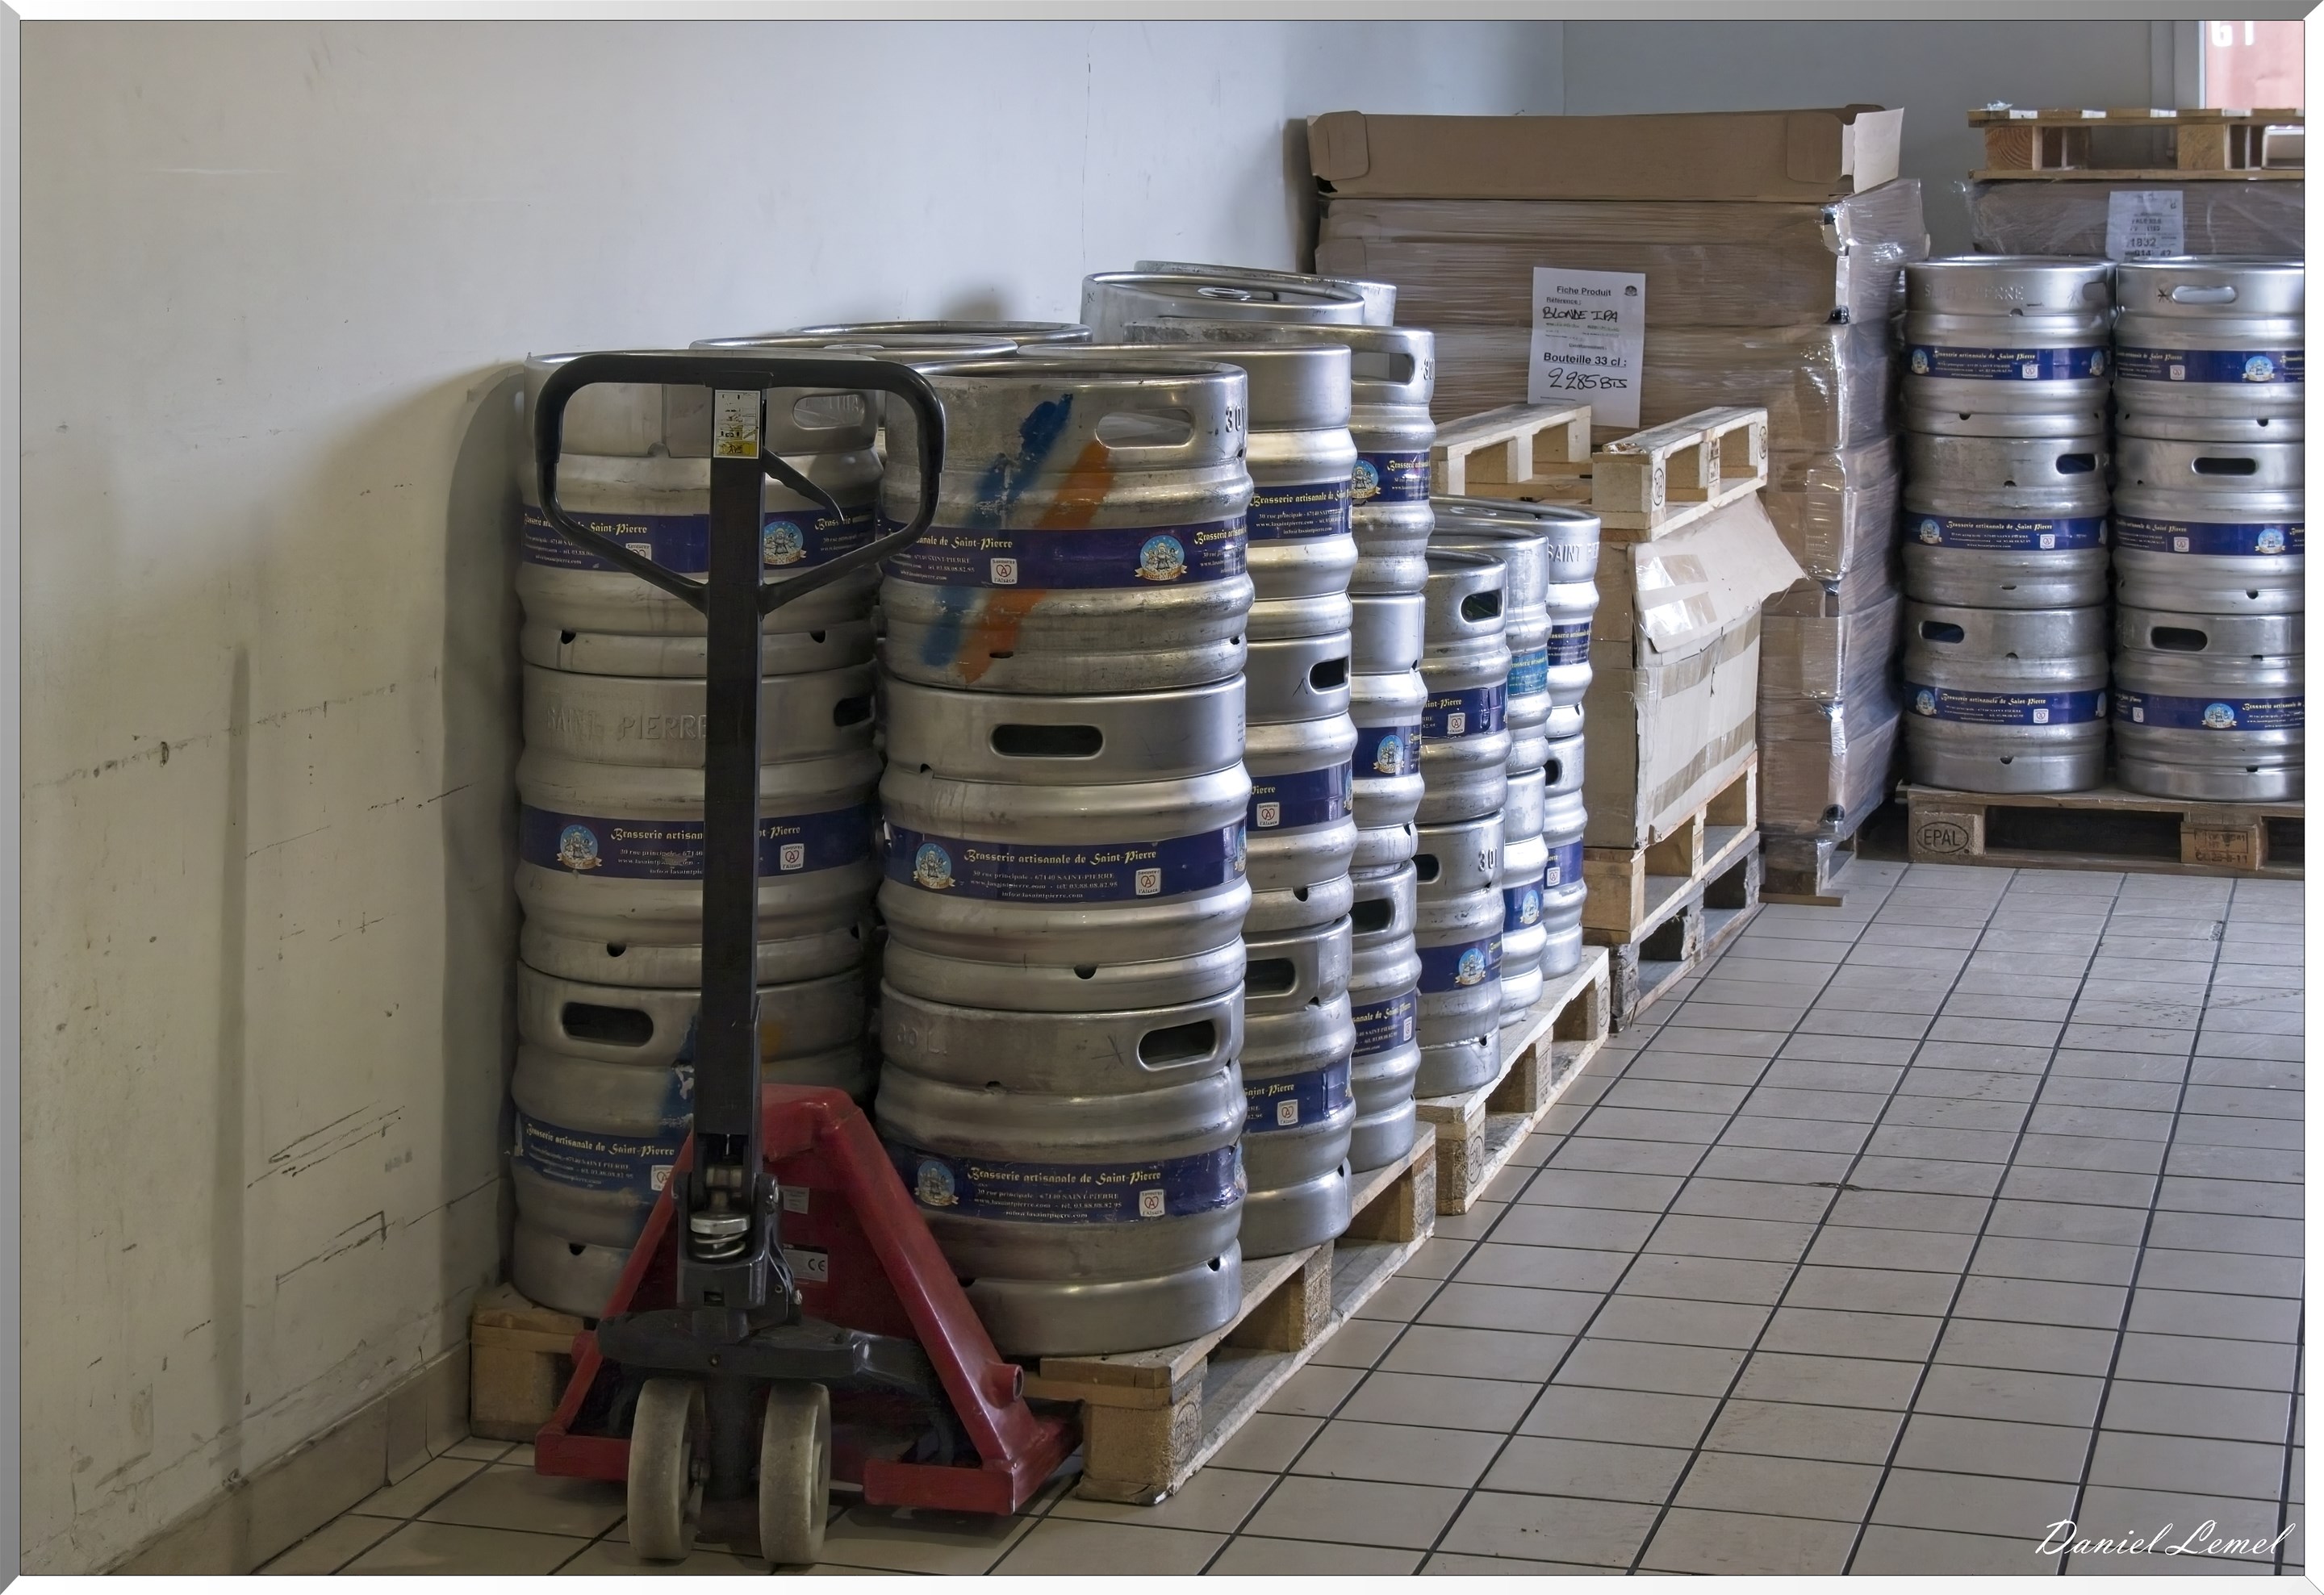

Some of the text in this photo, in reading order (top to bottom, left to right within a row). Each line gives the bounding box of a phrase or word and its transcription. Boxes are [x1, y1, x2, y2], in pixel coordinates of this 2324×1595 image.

[1556, 286, 1611, 297] Fiche Produit
[1542, 307, 1618, 323] BLONDE IPA
[1544, 353, 1591, 365] Bouteille
[1595, 357, 1607, 365] 33
[1611, 357, 1620, 366] cl
[1250, 493, 1294, 507] Brasserie
[1295, 492, 1327, 503] artisanale
[1327, 491, 1334, 500] de
[814, 516, 852, 530] Brassrie
[939, 536, 949, 545] de
[951, 537, 1013, 550] Saint-Pierre
[1193, 529, 1227, 545] Brasserie
[610, 828, 703, 841] Brasserie artisan
[1924, 829, 1961, 846] EPAL
[963, 849, 1156, 866] Brasserie artisanale de Saint-Pierre
[994, 872, 1028, 880] principale
[1057, 872, 1114, 880] SAINT-PIERRE
[1375, 1010, 1382, 1019] de
[554, 1136, 593, 1150] artisanale
[596, 1142, 605, 1152] de
[608, 1143, 675, 1158] Saint-Pierre
[967, 1167, 1161, 1185] Brasserie artisanale de Saint-Pierre
